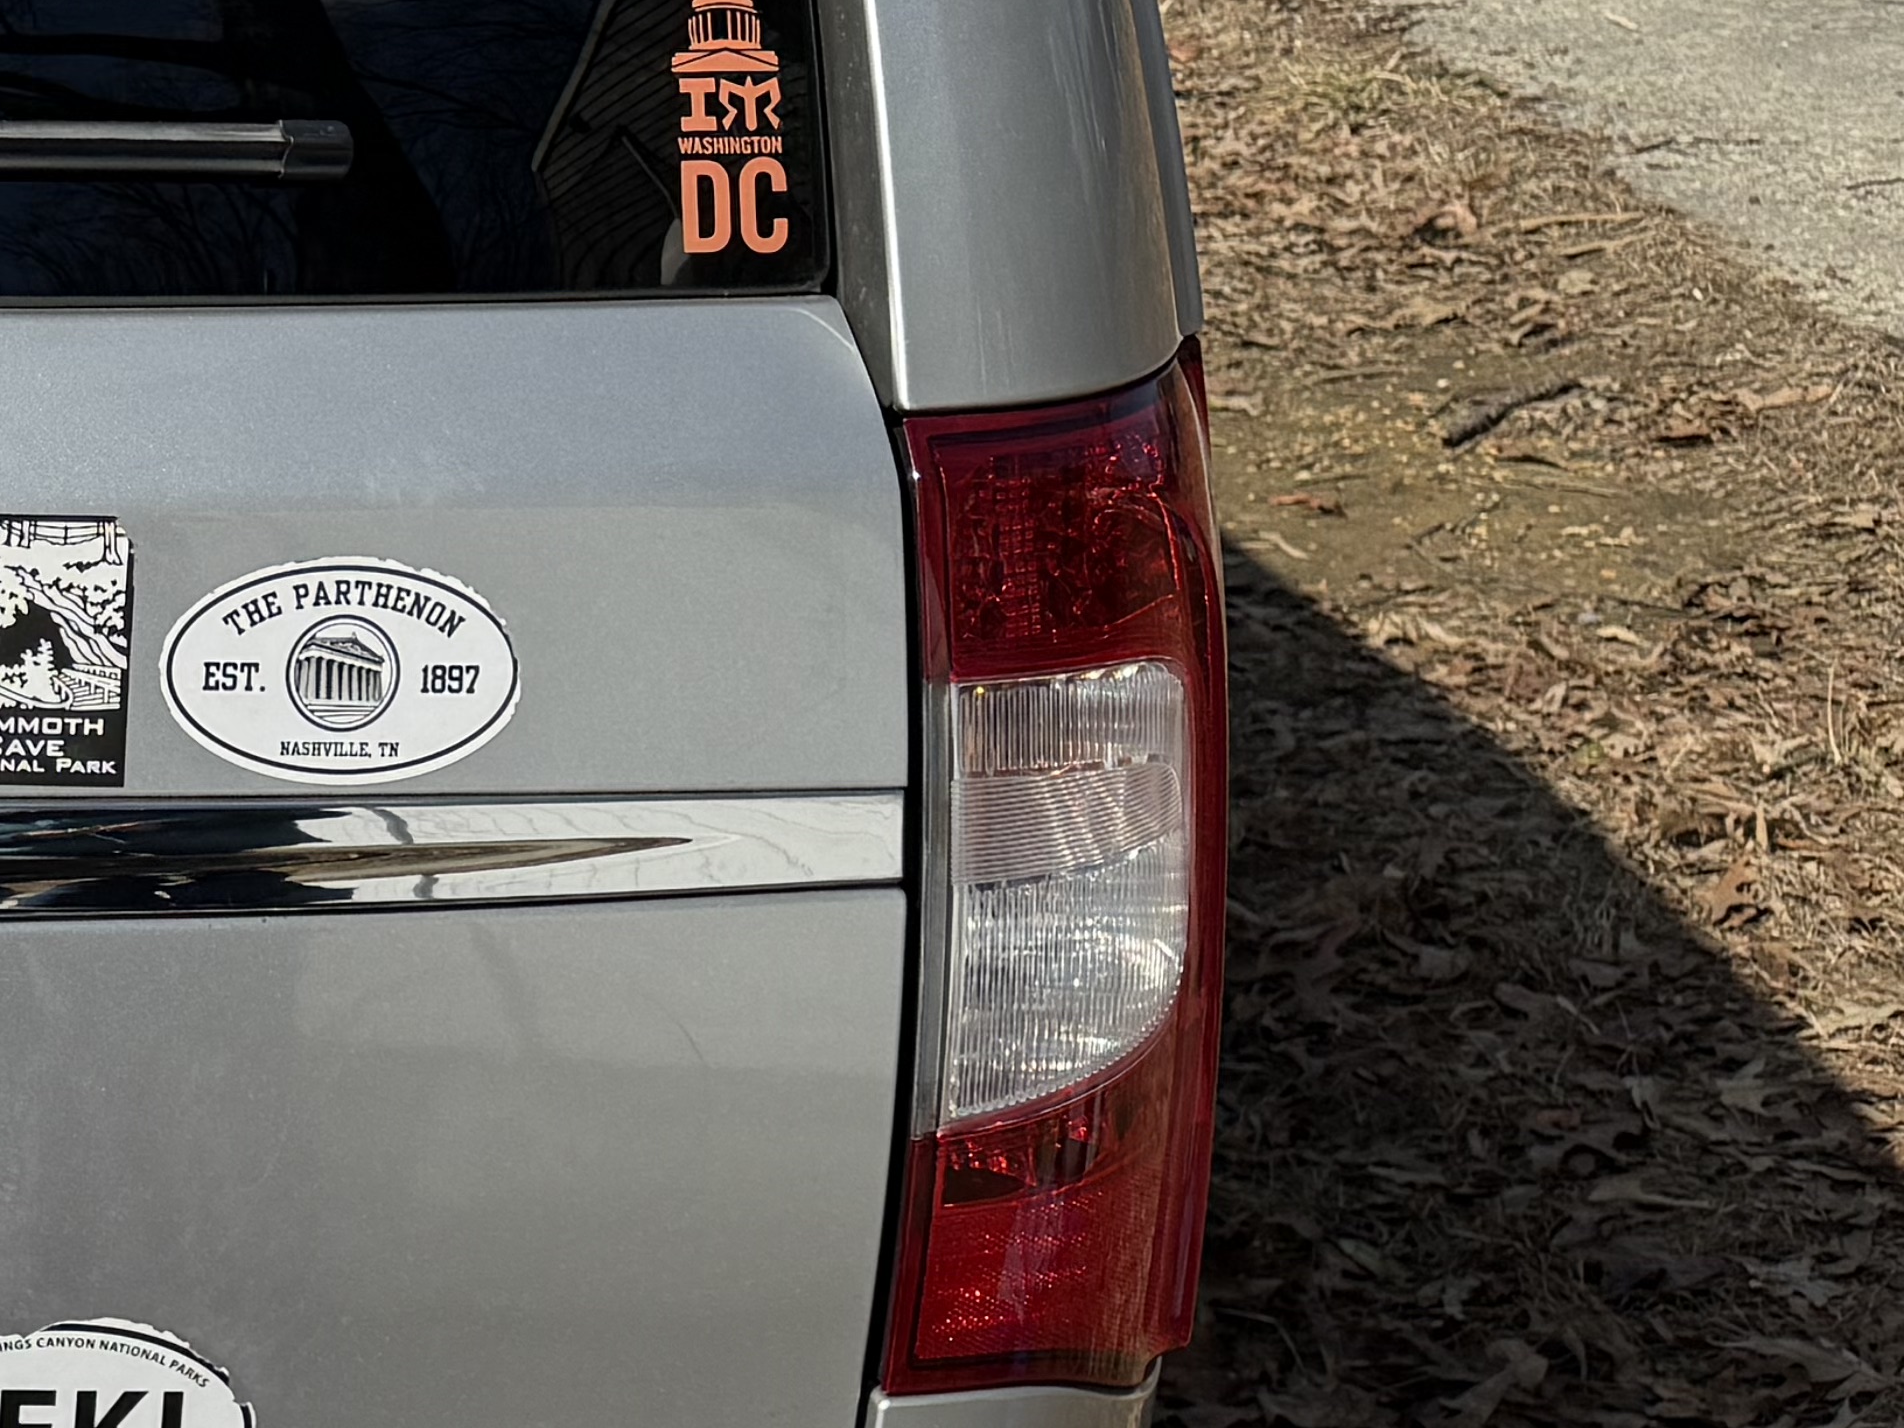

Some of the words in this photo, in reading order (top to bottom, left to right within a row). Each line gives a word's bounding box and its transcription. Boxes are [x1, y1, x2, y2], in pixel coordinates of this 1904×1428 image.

[677, 135, 783, 155] WASHINGTON
[680, 155, 789, 254] DC
[221, 590, 283, 637] THE
[292, 579, 467, 639] PARTHENON
[201, 661, 267, 693] EST.
[419, 664, 481, 694] 1897
[279, 740, 373, 760] NASHVILLE,
[378, 742, 400, 758] TN
[35, 1336, 96, 1350] CANYON
[98, 1338, 168, 1369] NATIONAL
[168, 1358, 211, 1389] PARKS
